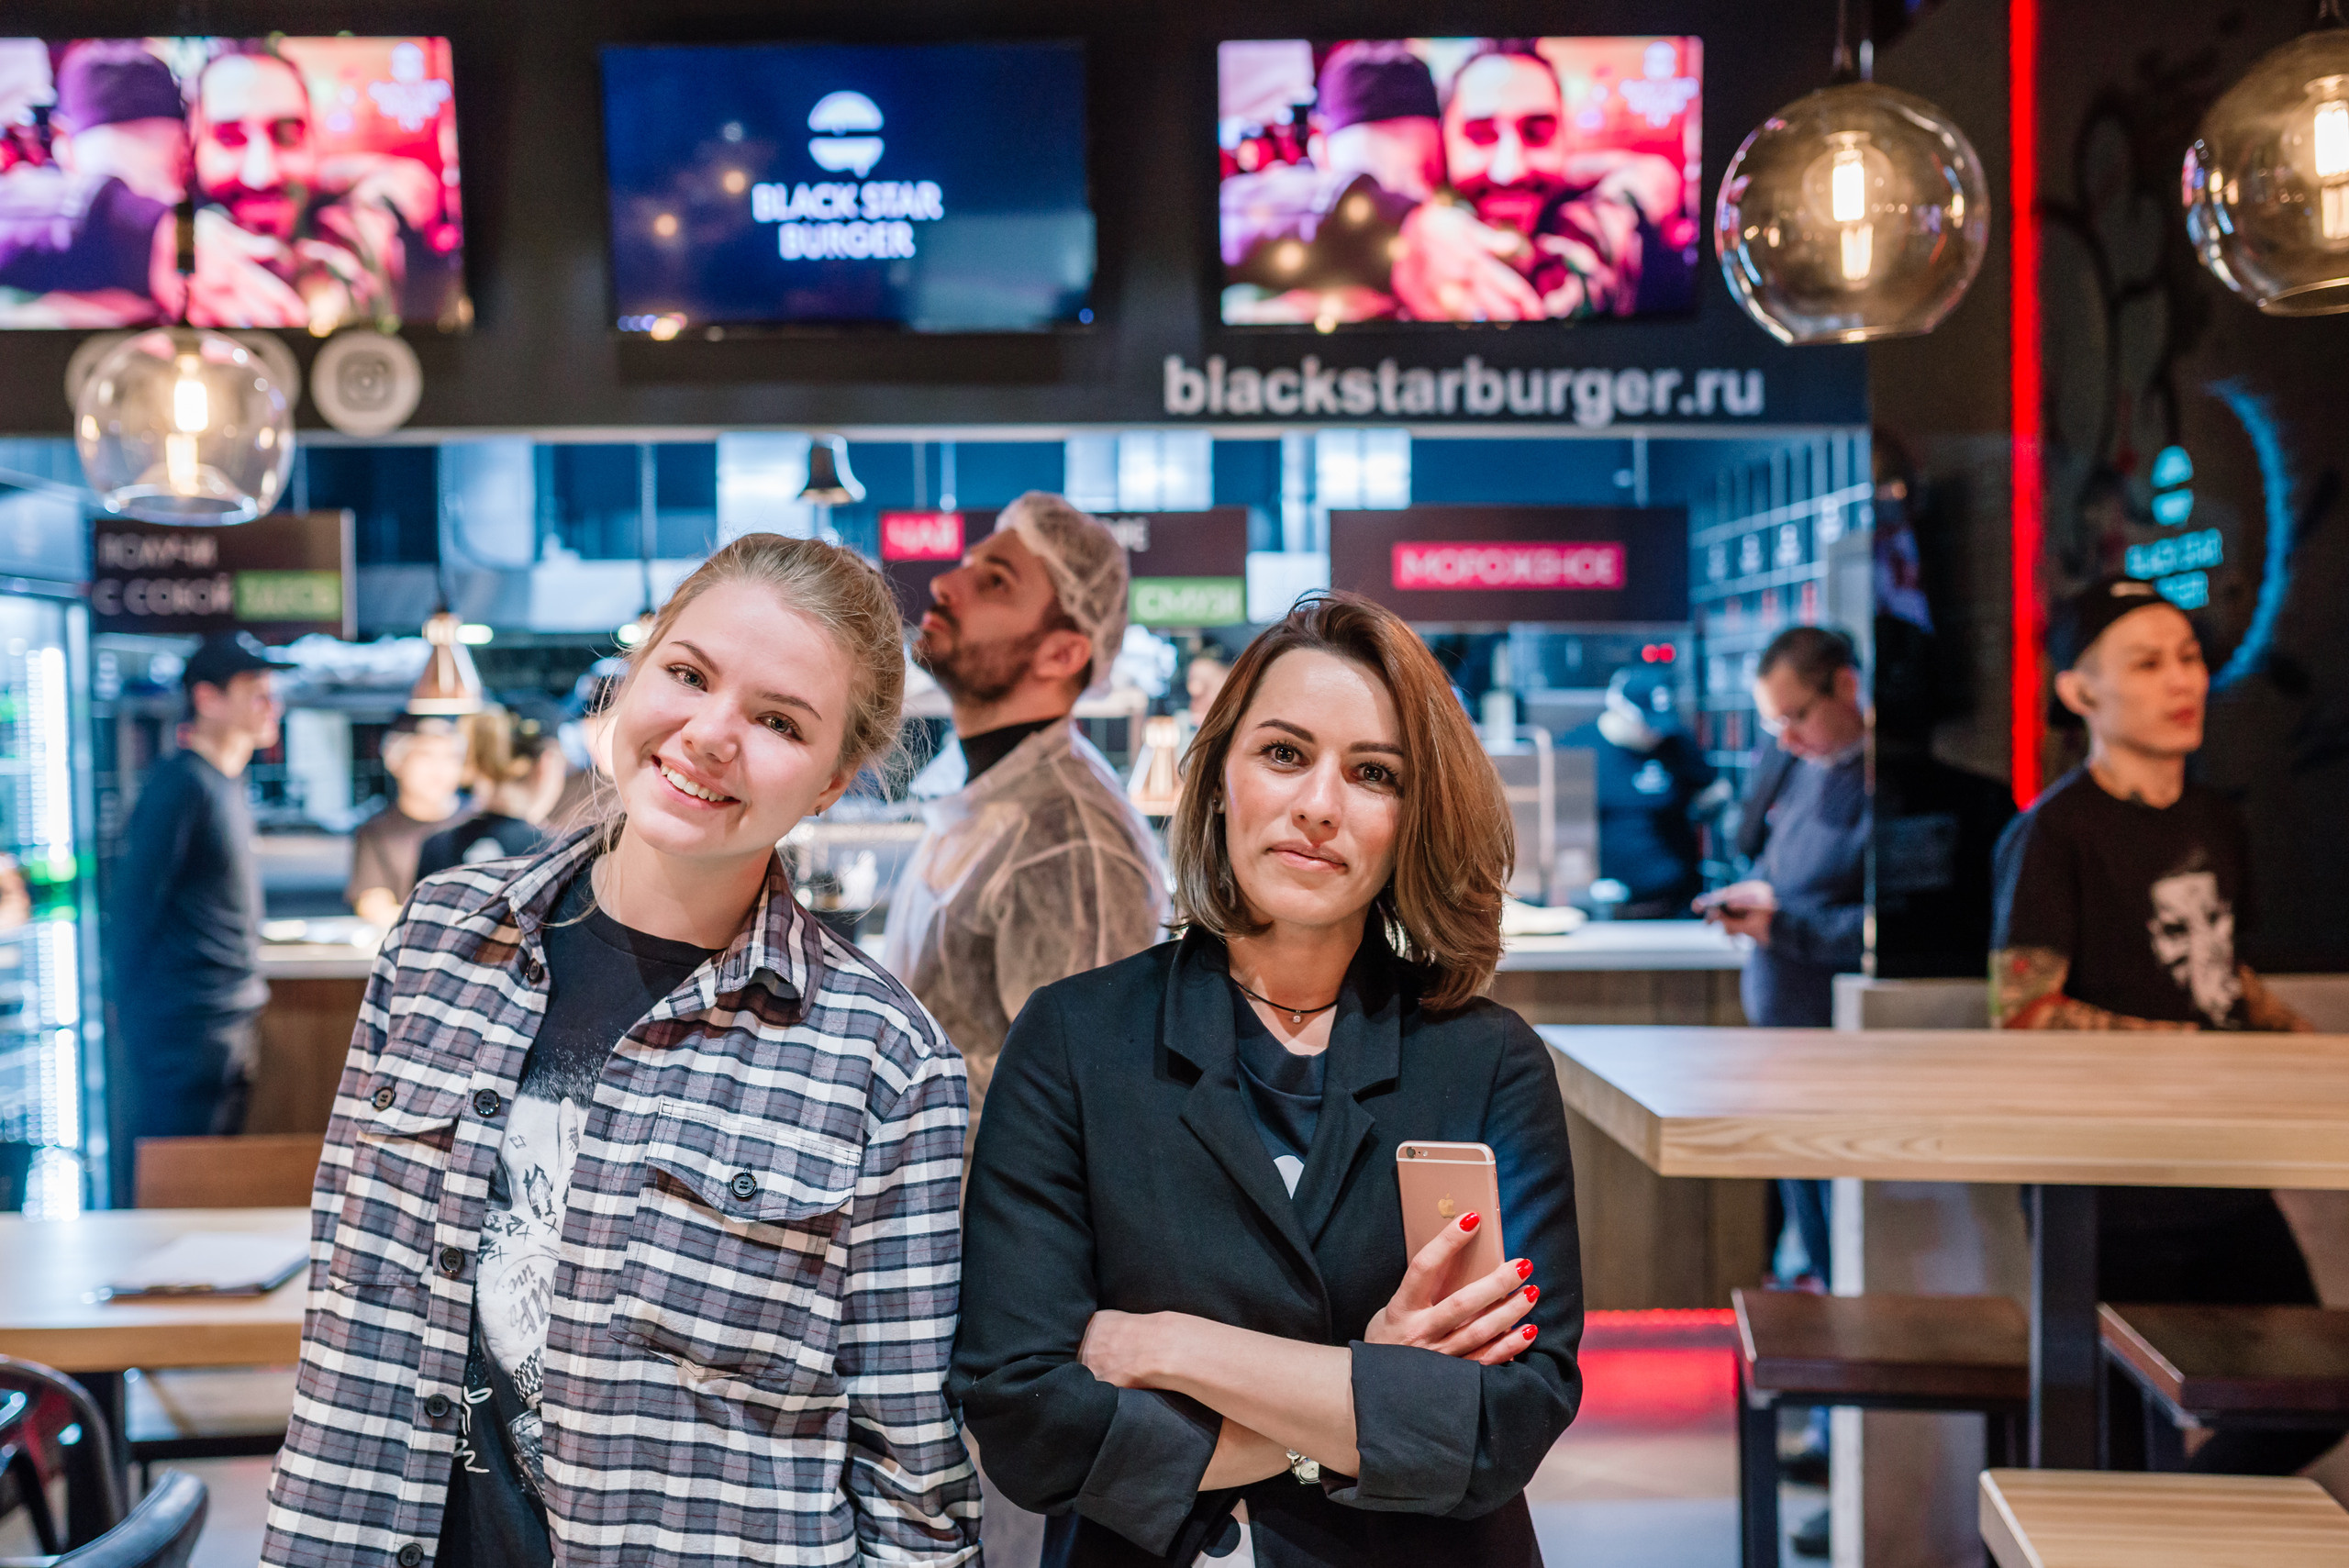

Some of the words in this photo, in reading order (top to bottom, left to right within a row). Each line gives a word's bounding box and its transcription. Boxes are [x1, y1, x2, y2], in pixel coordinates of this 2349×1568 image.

[751, 182, 859, 223] BLACK
[860, 180, 944, 221] STAR
[778, 221, 916, 261] BURGER
[1163, 355, 1764, 428] blackstarburger.ru
